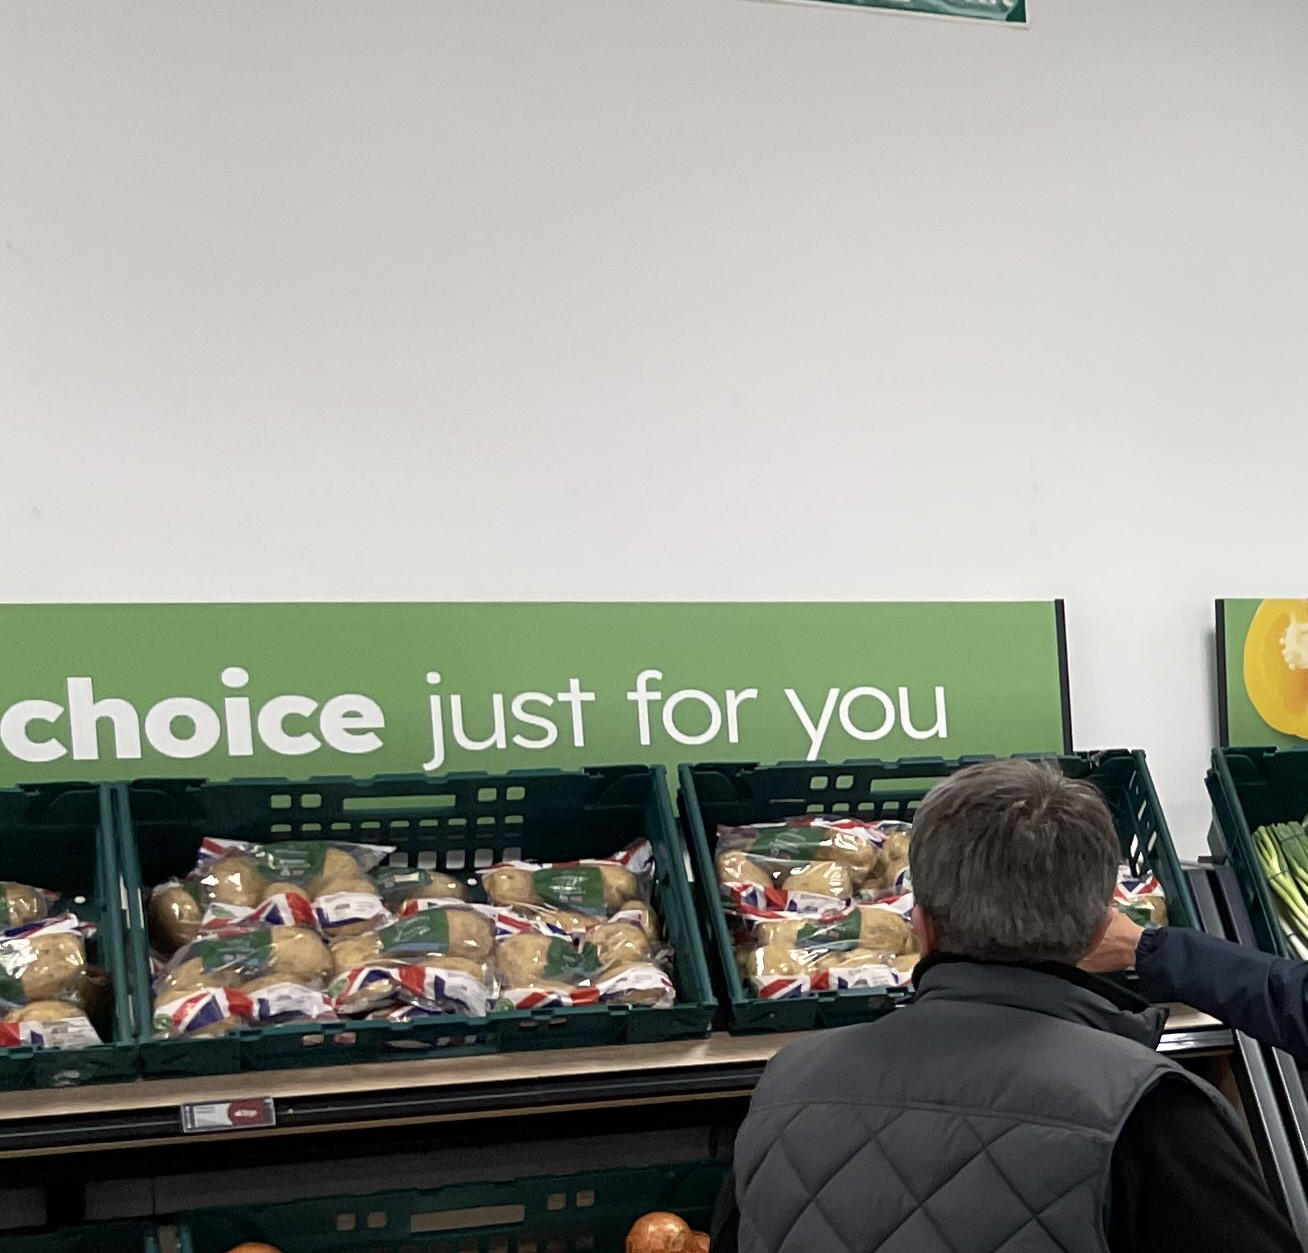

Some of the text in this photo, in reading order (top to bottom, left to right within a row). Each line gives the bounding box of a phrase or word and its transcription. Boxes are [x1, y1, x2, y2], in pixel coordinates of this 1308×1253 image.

[0, 666, 948, 771] choice just for you
